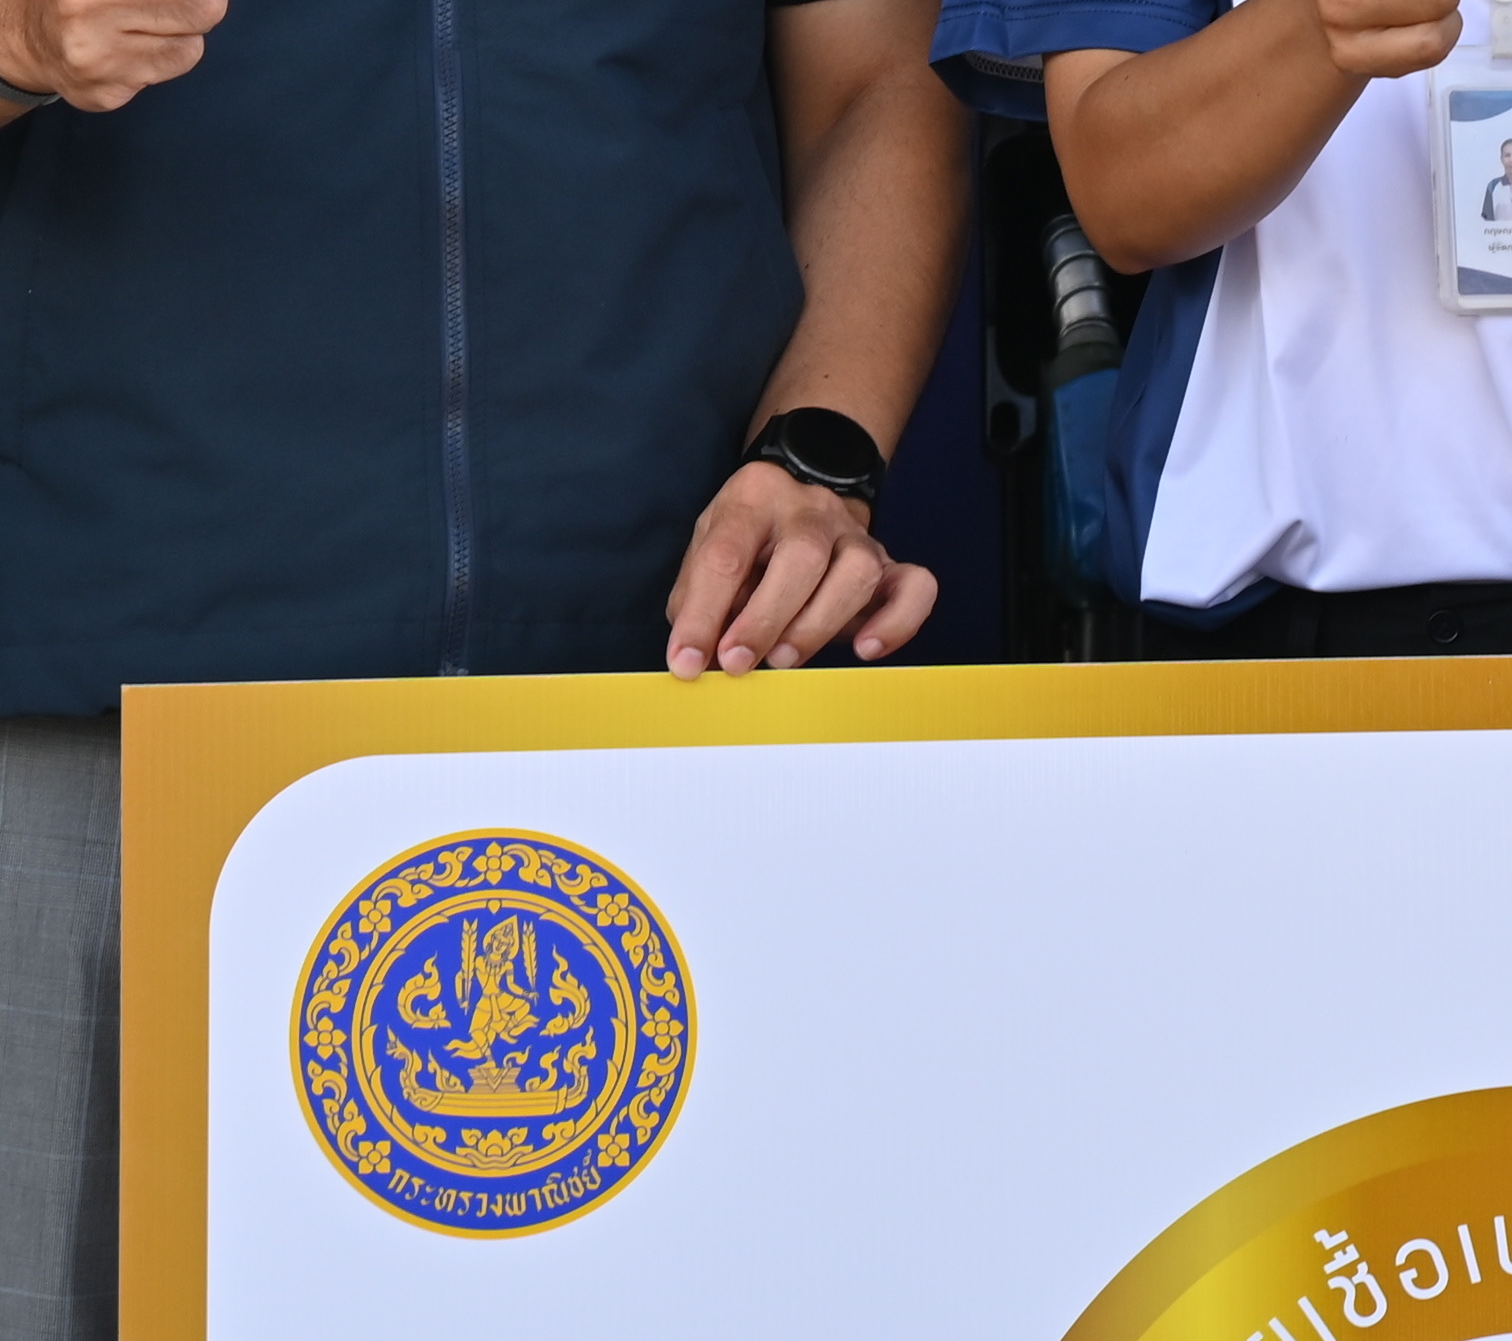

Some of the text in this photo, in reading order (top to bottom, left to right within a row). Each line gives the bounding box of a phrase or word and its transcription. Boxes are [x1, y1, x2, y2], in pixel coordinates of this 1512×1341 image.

[388, 1165, 602, 1218] กระทรวงพาณิชย์
